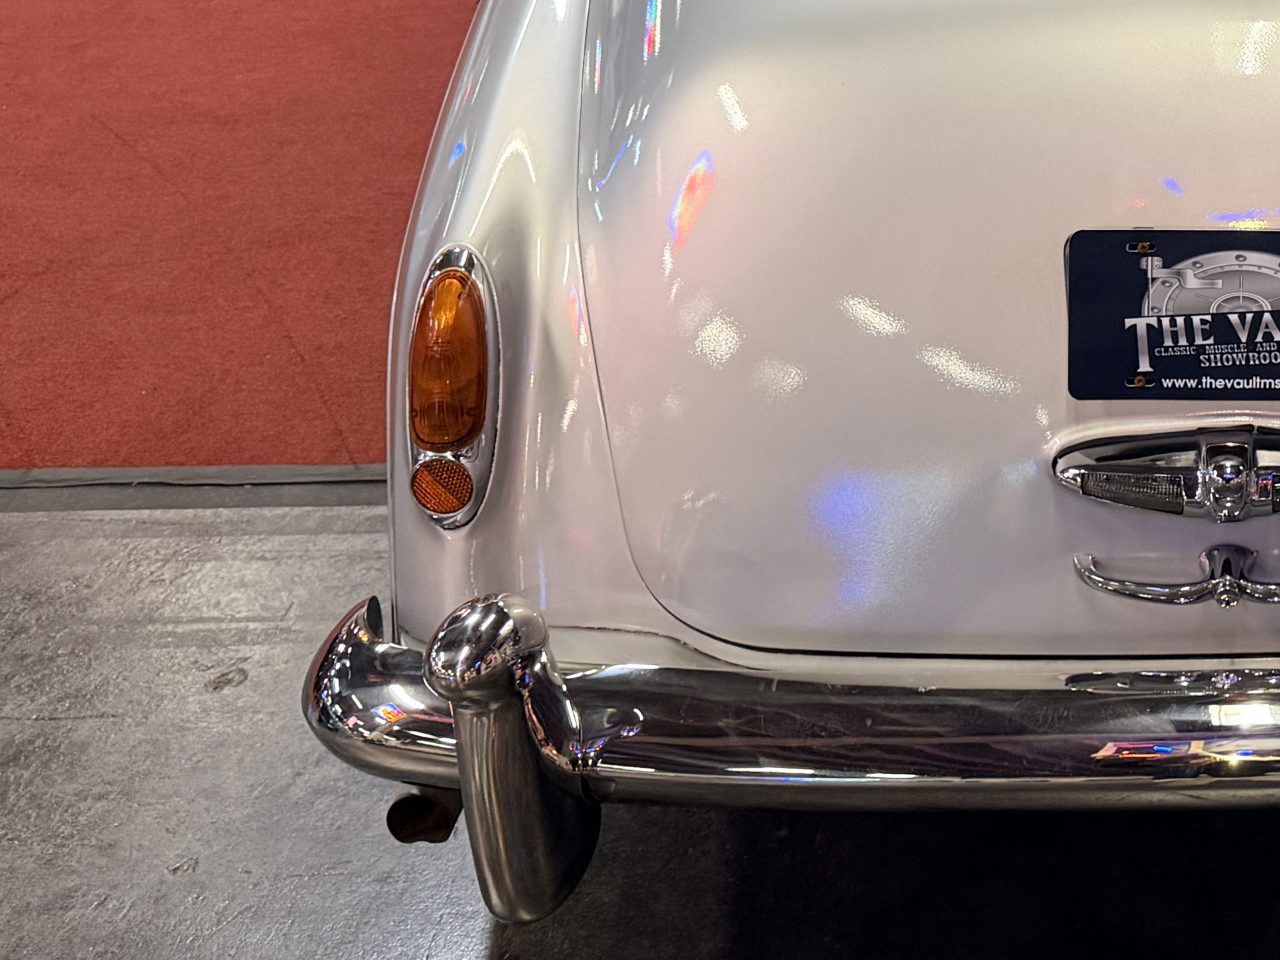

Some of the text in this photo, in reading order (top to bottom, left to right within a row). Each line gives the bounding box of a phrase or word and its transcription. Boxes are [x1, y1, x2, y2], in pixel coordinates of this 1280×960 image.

[1124, 315, 1214, 373] THE
[1154, 346, 1198, 356] CLASSIC
[1205, 343, 1248, 354] MUSCLE
[1255, 342, 1278, 352] AND
